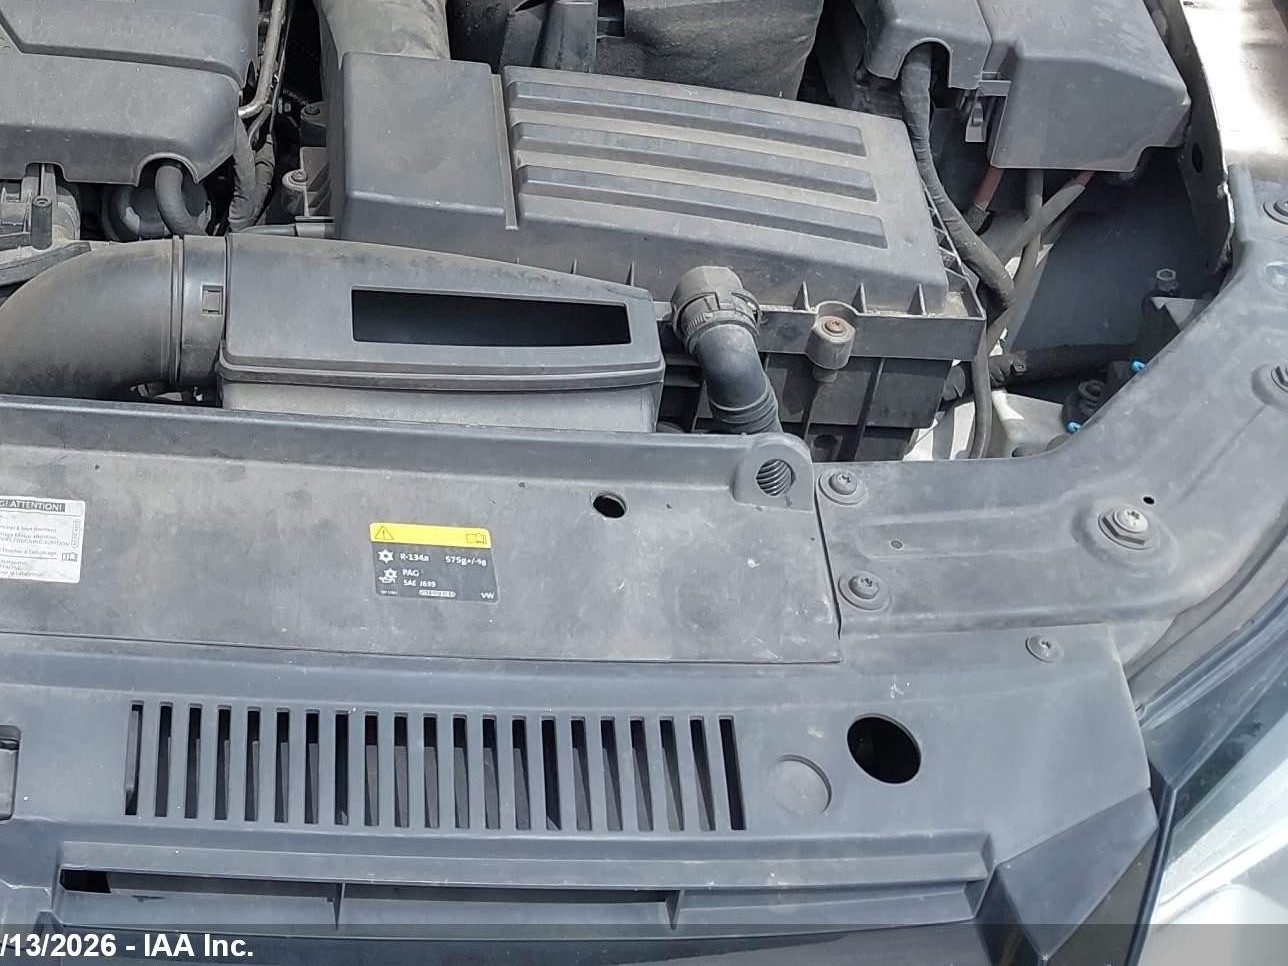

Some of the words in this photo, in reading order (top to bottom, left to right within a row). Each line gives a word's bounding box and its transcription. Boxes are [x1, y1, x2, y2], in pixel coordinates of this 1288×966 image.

[10, 500, 63, 512] ATTENTION!
[400, 553, 430, 562] R-134a
[402, 568, 420, 577] PAG
[403, 578, 417, 587] SAE
[419, 580, 437, 588] J639
[480, 591, 495, 600] VW
